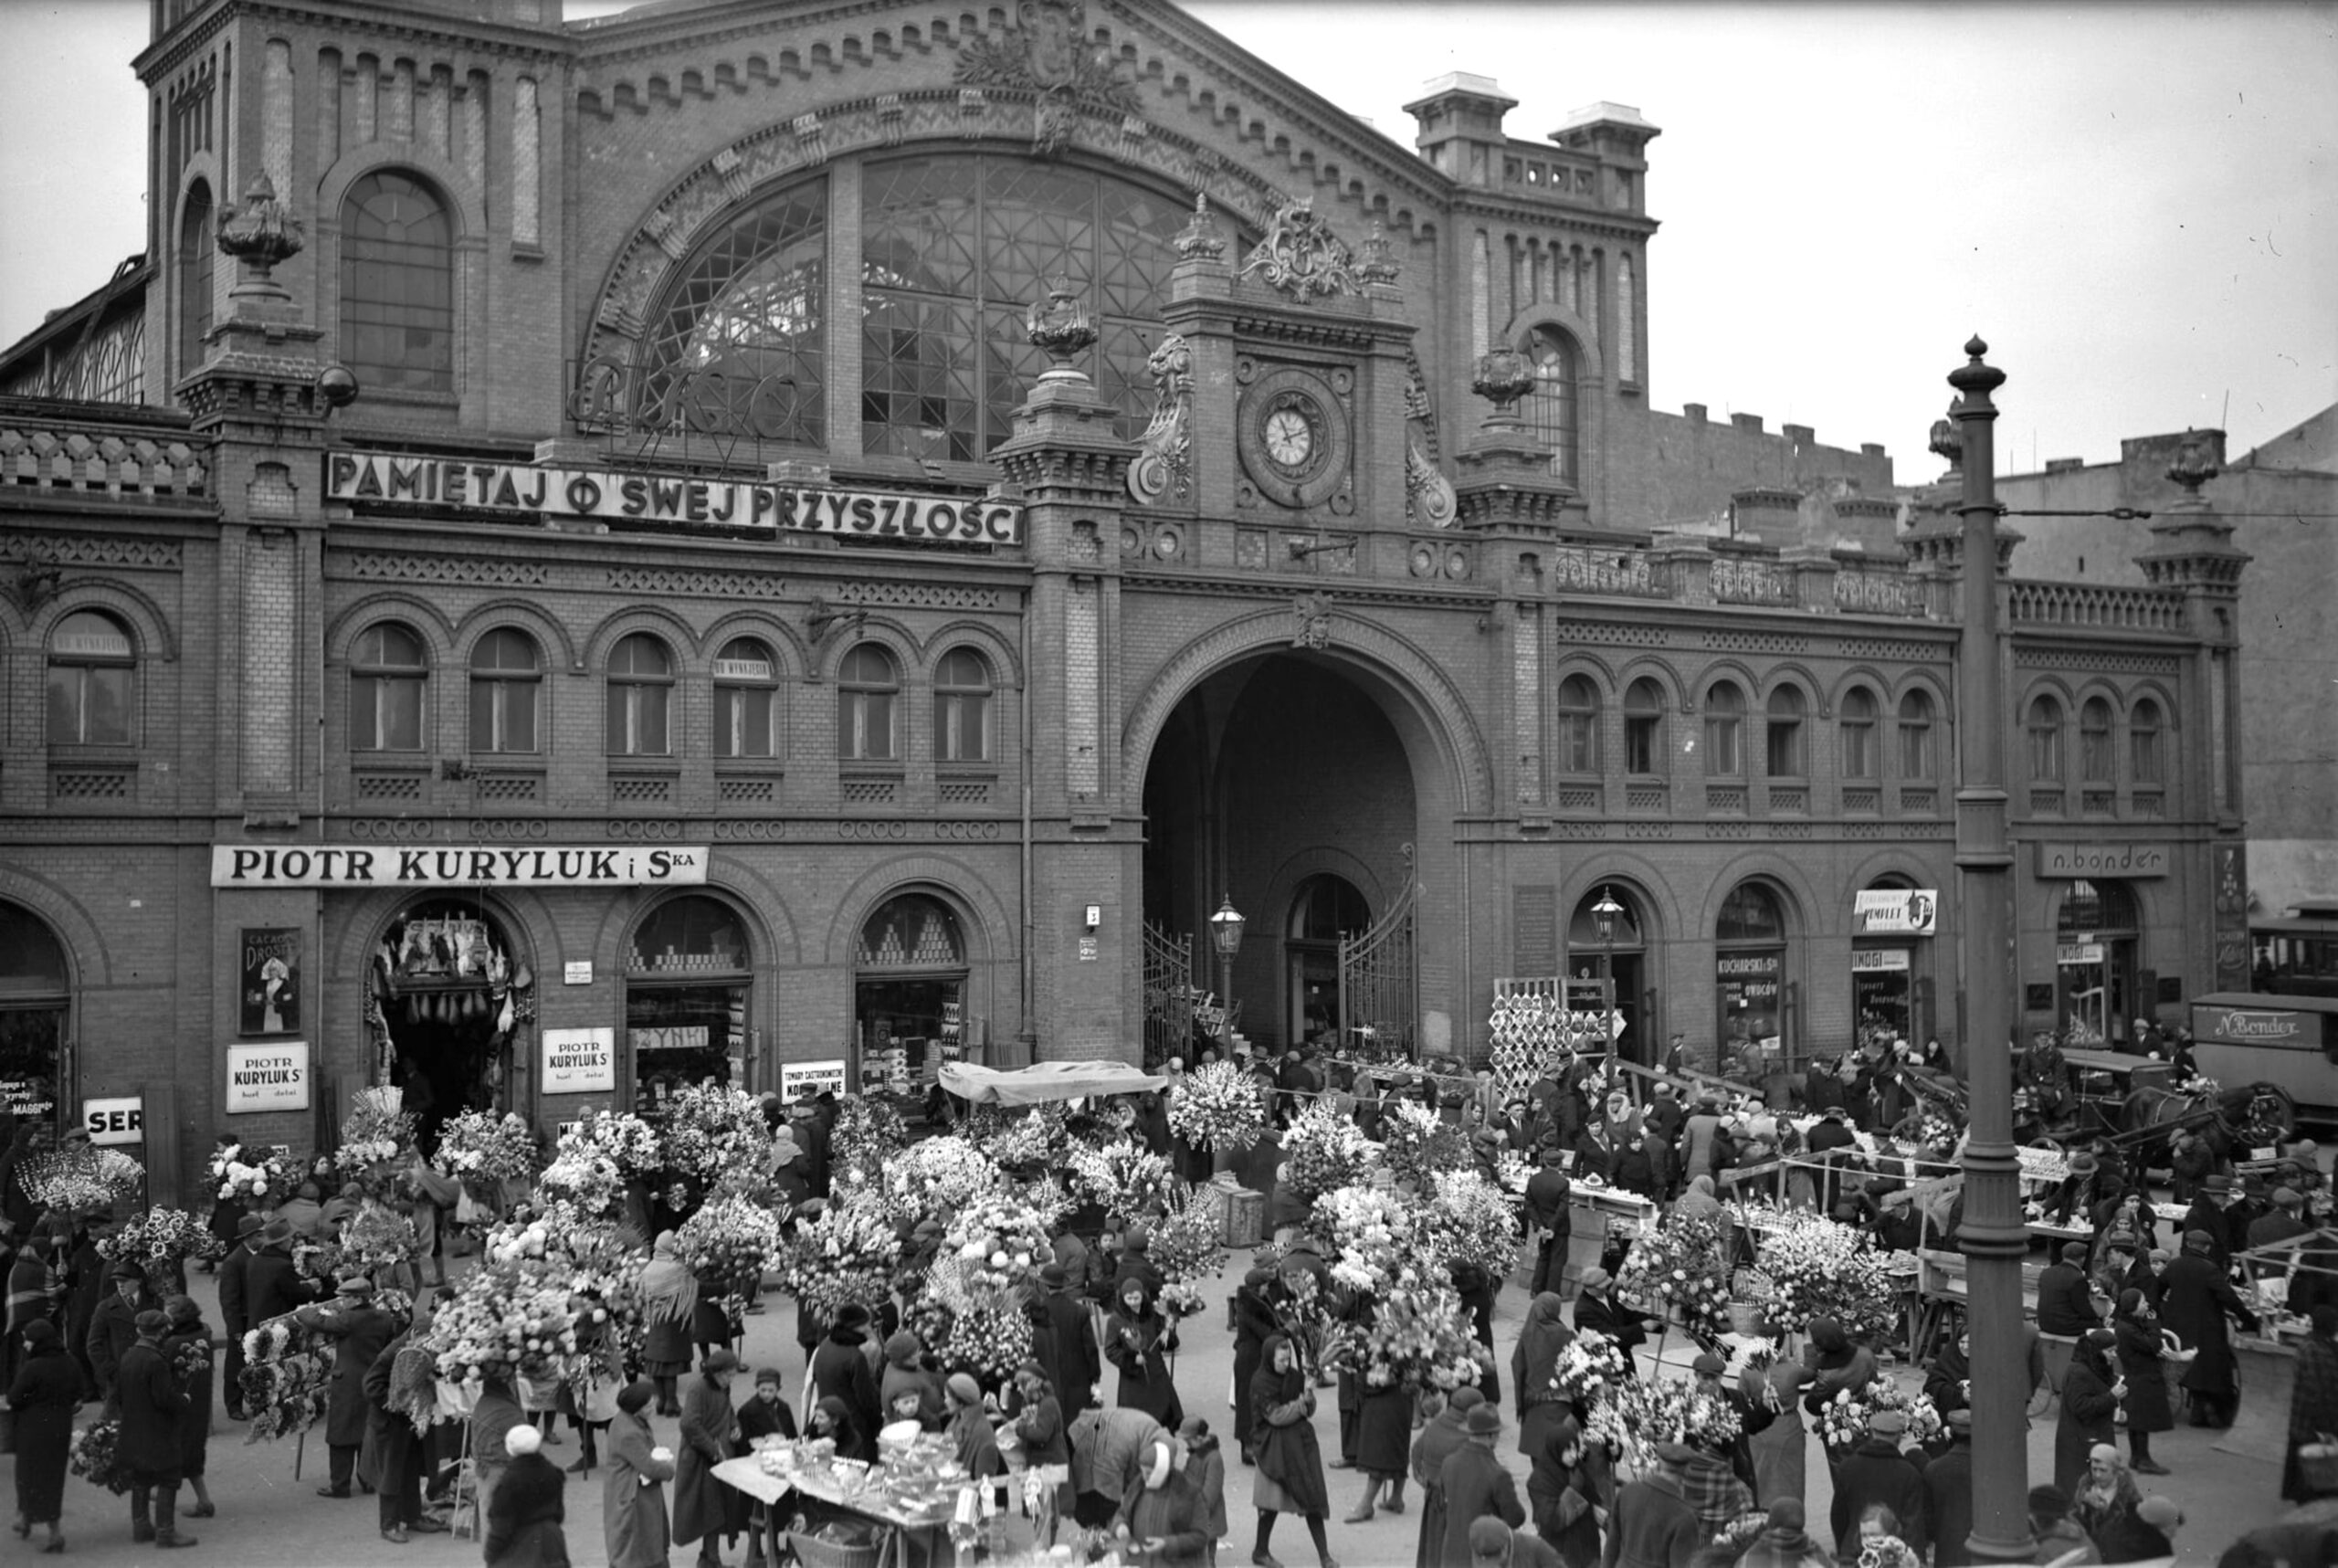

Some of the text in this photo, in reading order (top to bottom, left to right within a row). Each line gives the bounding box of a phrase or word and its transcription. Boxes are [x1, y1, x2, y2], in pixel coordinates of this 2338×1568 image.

[332, 457, 1024, 543] PAMIĘTAJ O SWEJ PRZYSZŁOŚCI
[232, 849, 375, 880] PIOTR
[398, 849, 620, 881] KURYLUK
[627, 857, 636, 879] i
[639, 1027, 706, 1047] ZYNKI
[559, 1042, 601, 1053] PIOTR
[245, 1057, 292, 1069] PIOTR
[550, 1053, 598, 1068] KURYLUK
[234, 1068, 290, 1086] KURYLUK
